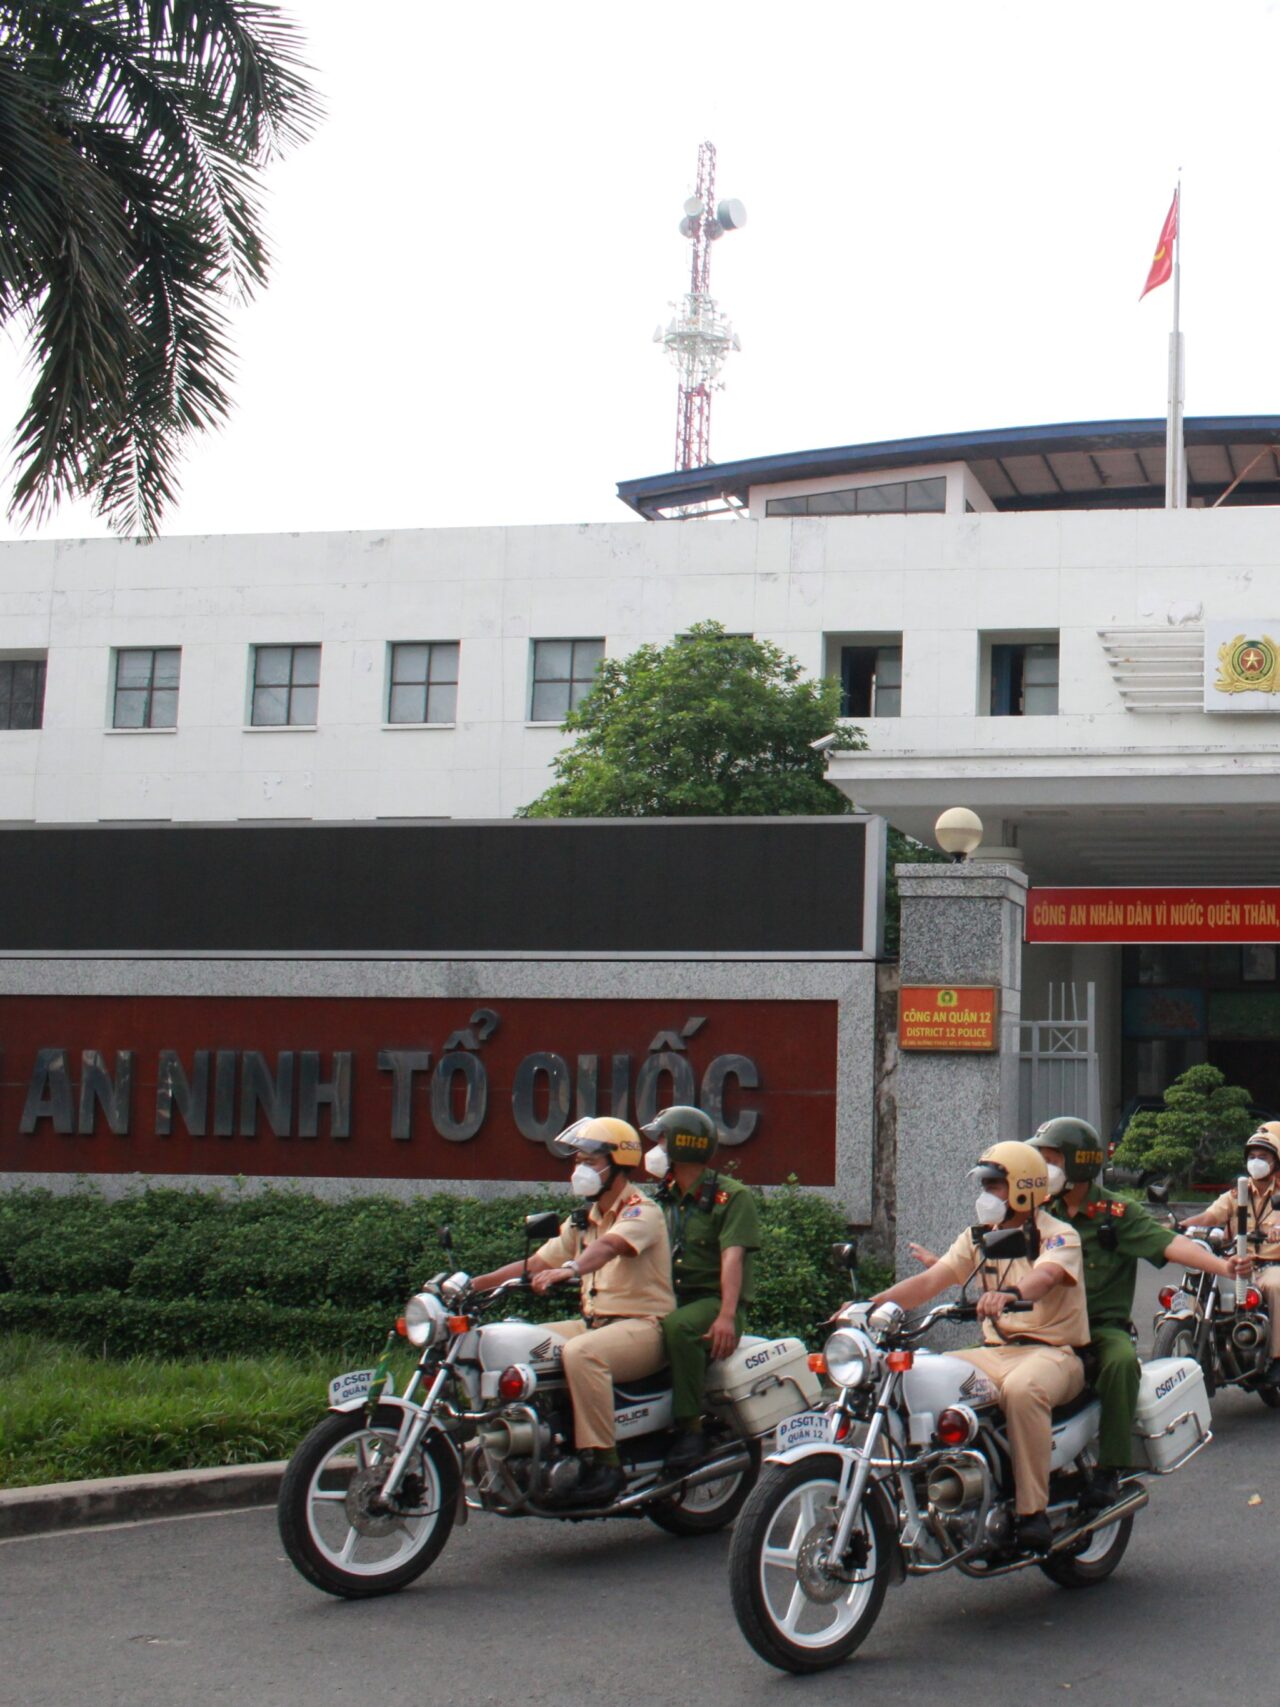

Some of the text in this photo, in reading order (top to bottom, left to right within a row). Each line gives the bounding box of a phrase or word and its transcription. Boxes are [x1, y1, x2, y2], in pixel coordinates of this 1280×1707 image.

[1033, 901, 1066, 926] CÔNG
[1069, 904, 1086, 925] AN
[1090, 900, 1124, 925] NHÂN
[1127, 900, 1152, 925] DÂN
[1155, 901, 1167, 925] VÌ
[1170, 898, 1203, 925] NƯỚC
[1207, 900, 1240, 928] QUÊN
[903, 1008, 991, 1025] CÔNG AN QUẬN 12
[907, 1027, 987, 1038] DISTRICT 12 POLICE
[19, 1009, 760, 1158] AN NINH TỔ QUỐC
[813, 1429, 823, 1440] 12
